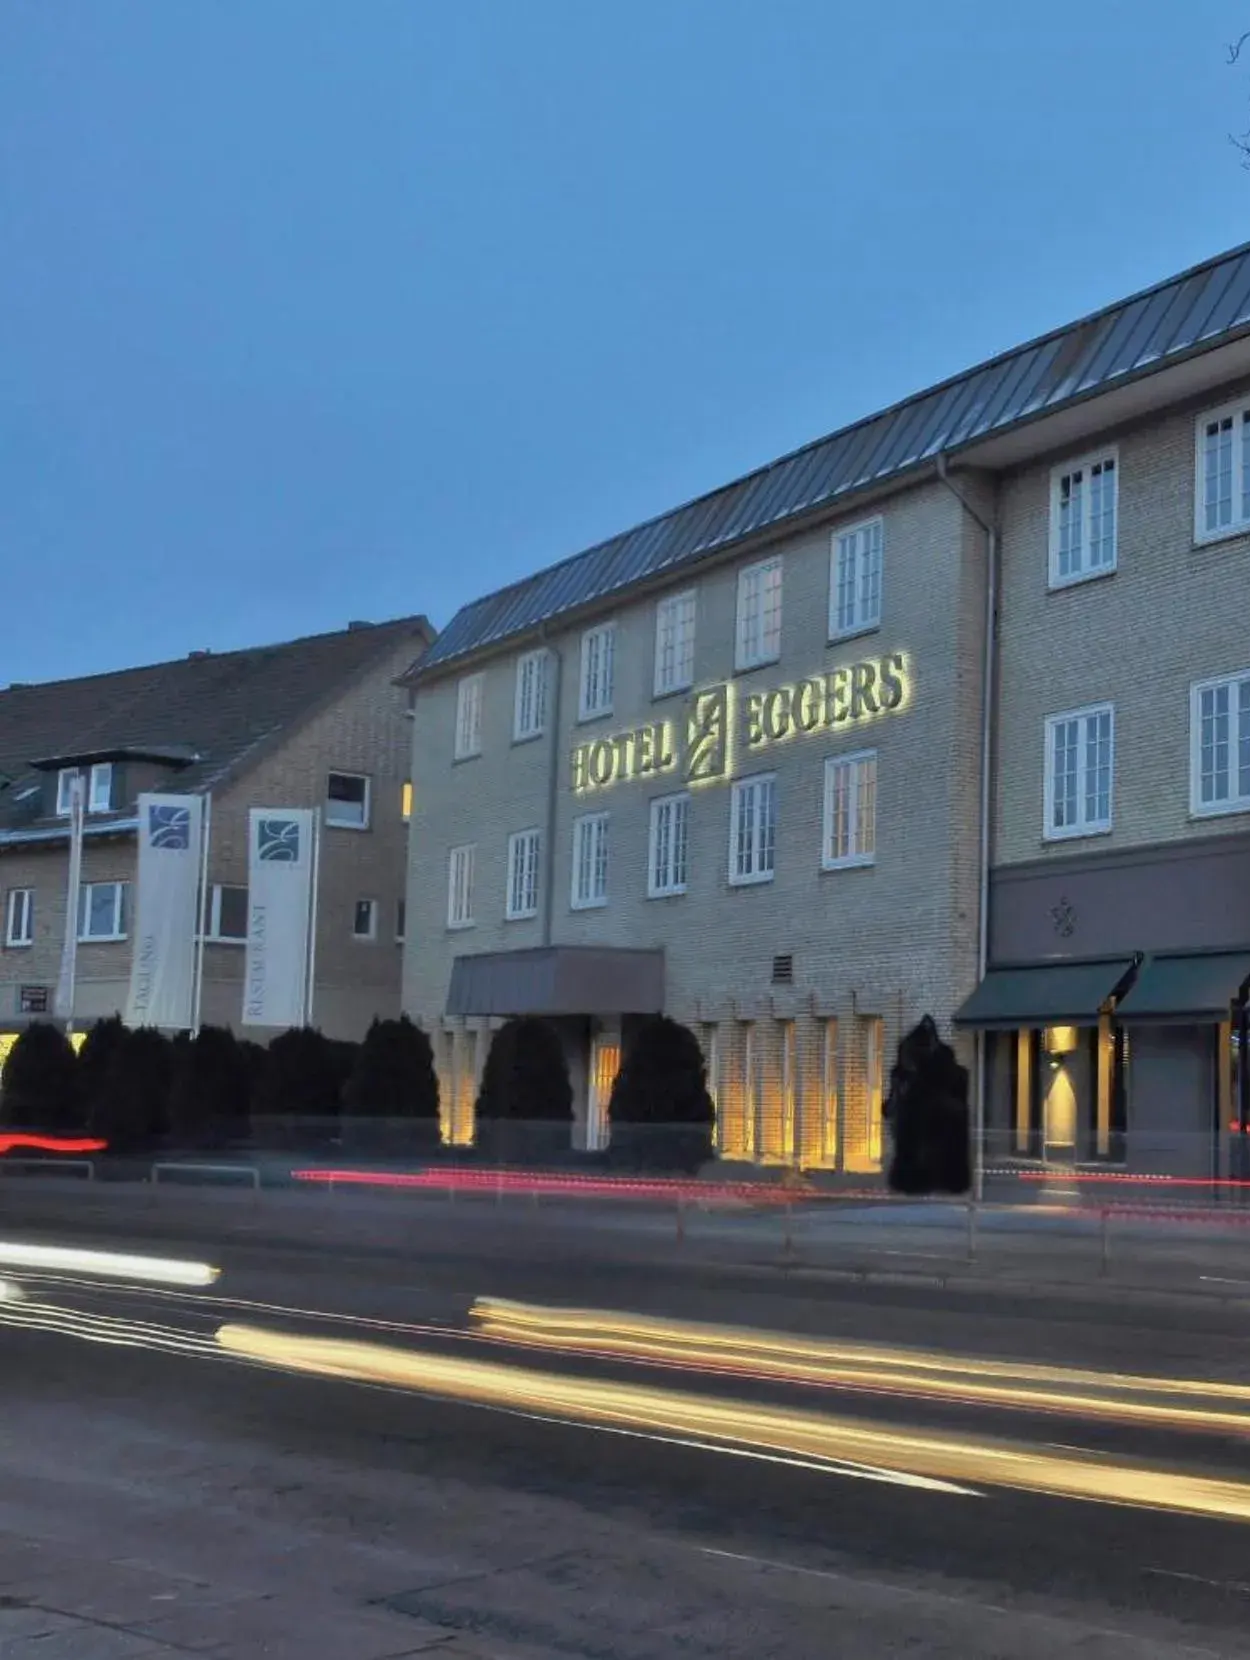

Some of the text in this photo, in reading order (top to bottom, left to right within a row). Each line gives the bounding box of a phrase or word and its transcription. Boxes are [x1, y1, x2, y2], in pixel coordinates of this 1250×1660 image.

[572, 653, 908, 790] HOTEL EGGERS
[248, 903, 267, 1017] RESTAURANT
